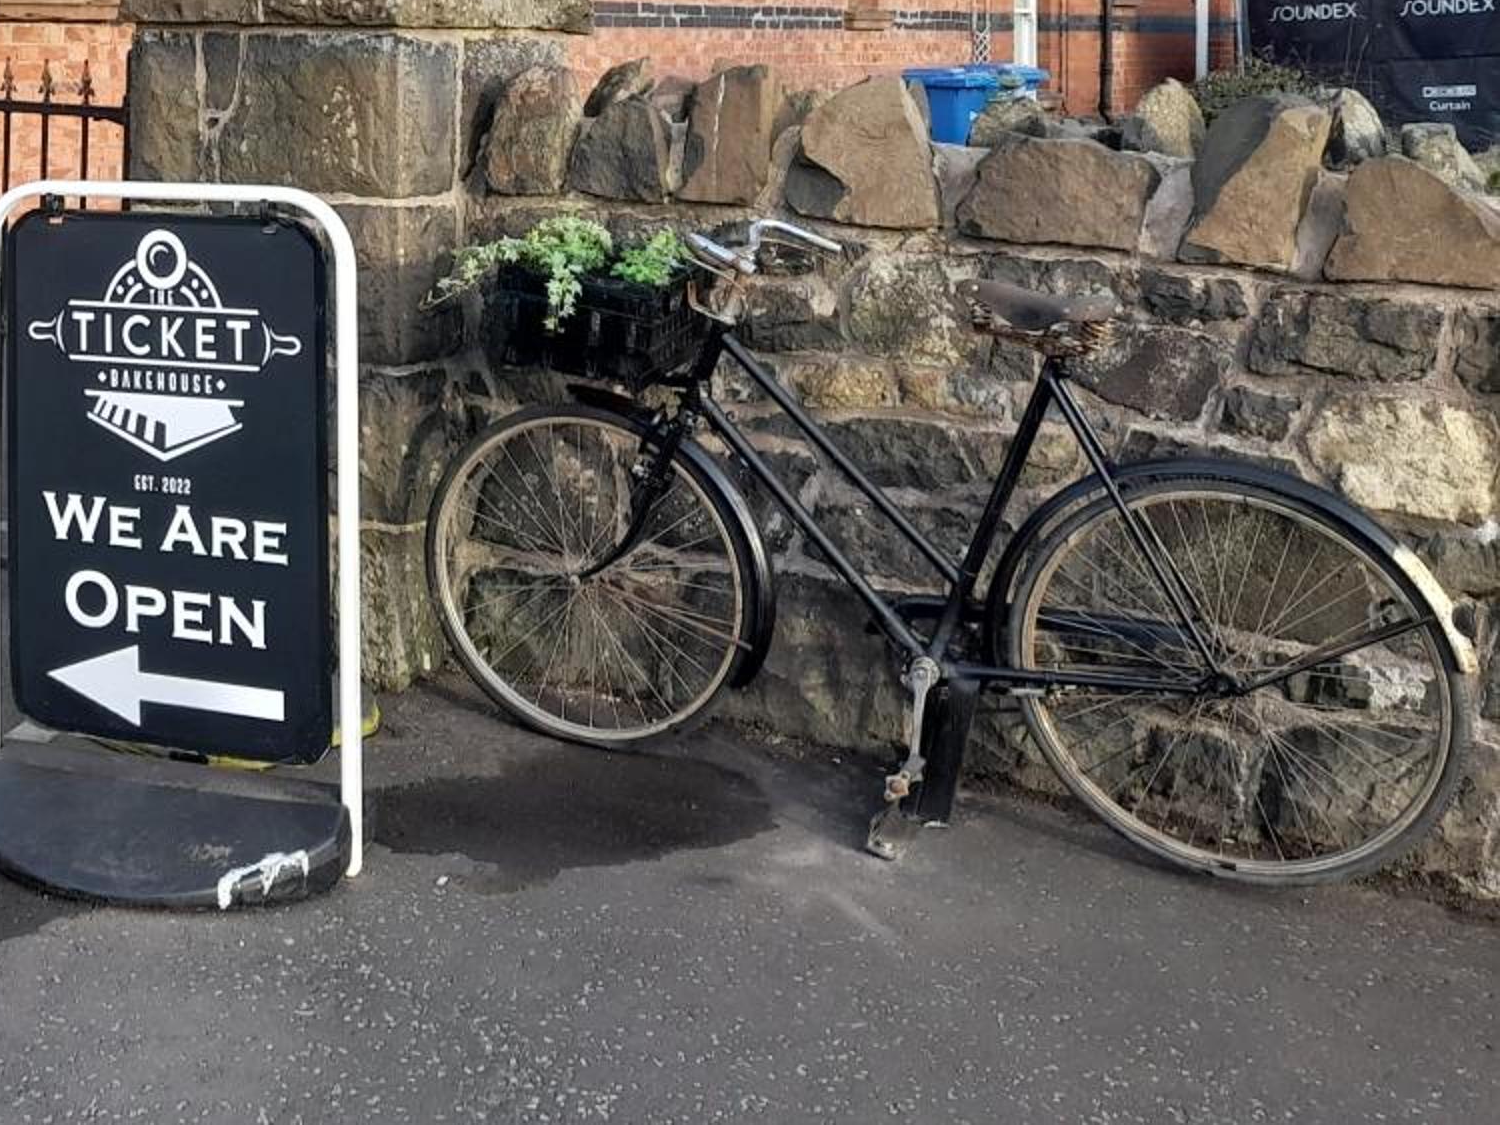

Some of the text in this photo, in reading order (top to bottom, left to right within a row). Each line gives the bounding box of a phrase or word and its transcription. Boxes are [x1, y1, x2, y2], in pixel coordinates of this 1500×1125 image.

[1269, 1, 1359, 22] SOUNDEX
[150, 288, 174, 306] THE
[71, 311, 251, 362] TICKET
[110, 368, 213, 395] BAKEHOUSE
[134, 474, 192, 495] EST. 2022
